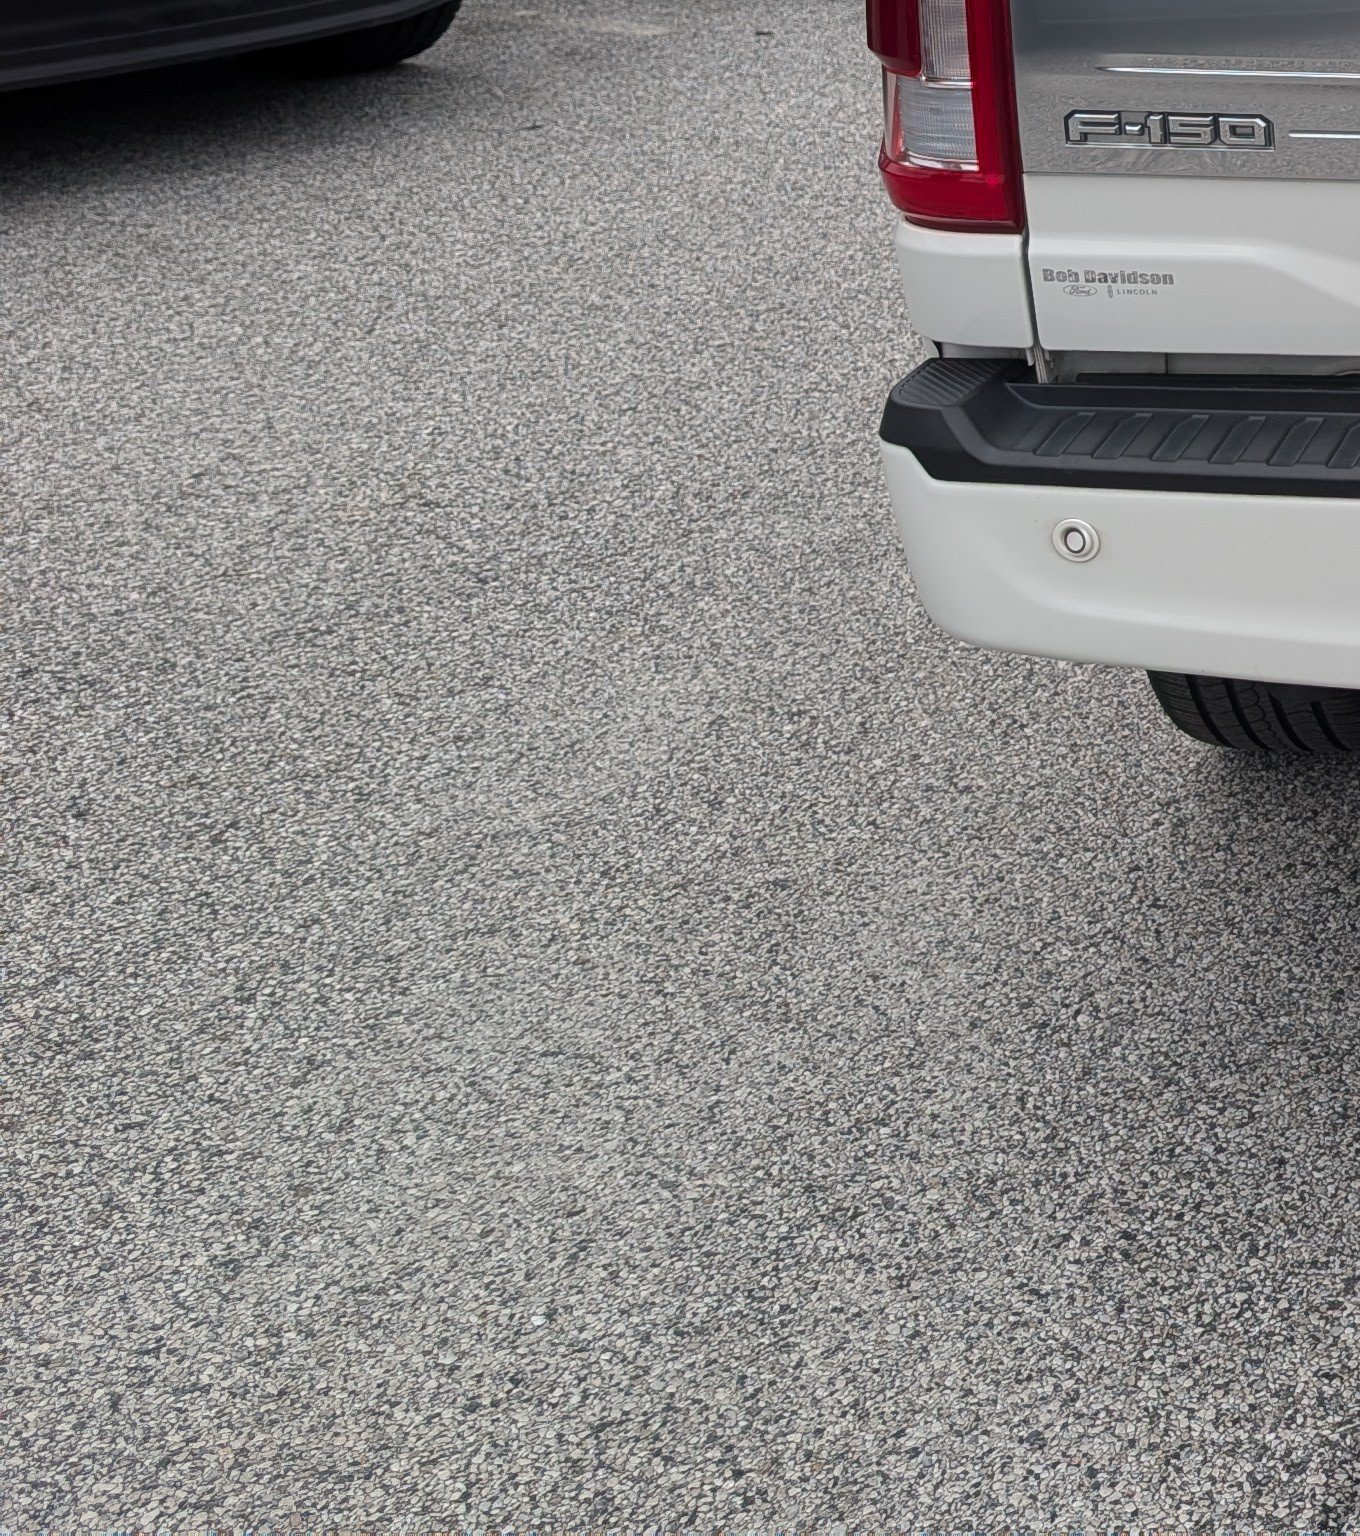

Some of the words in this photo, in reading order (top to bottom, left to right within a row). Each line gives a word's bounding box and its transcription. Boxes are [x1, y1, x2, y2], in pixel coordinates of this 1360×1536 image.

[1064, 109, 1275, 152] F-150
[1042, 268, 1080, 283] Bob
[1083, 269, 1175, 285] Davidson
[1116, 288, 1158, 296] LINCOLN
